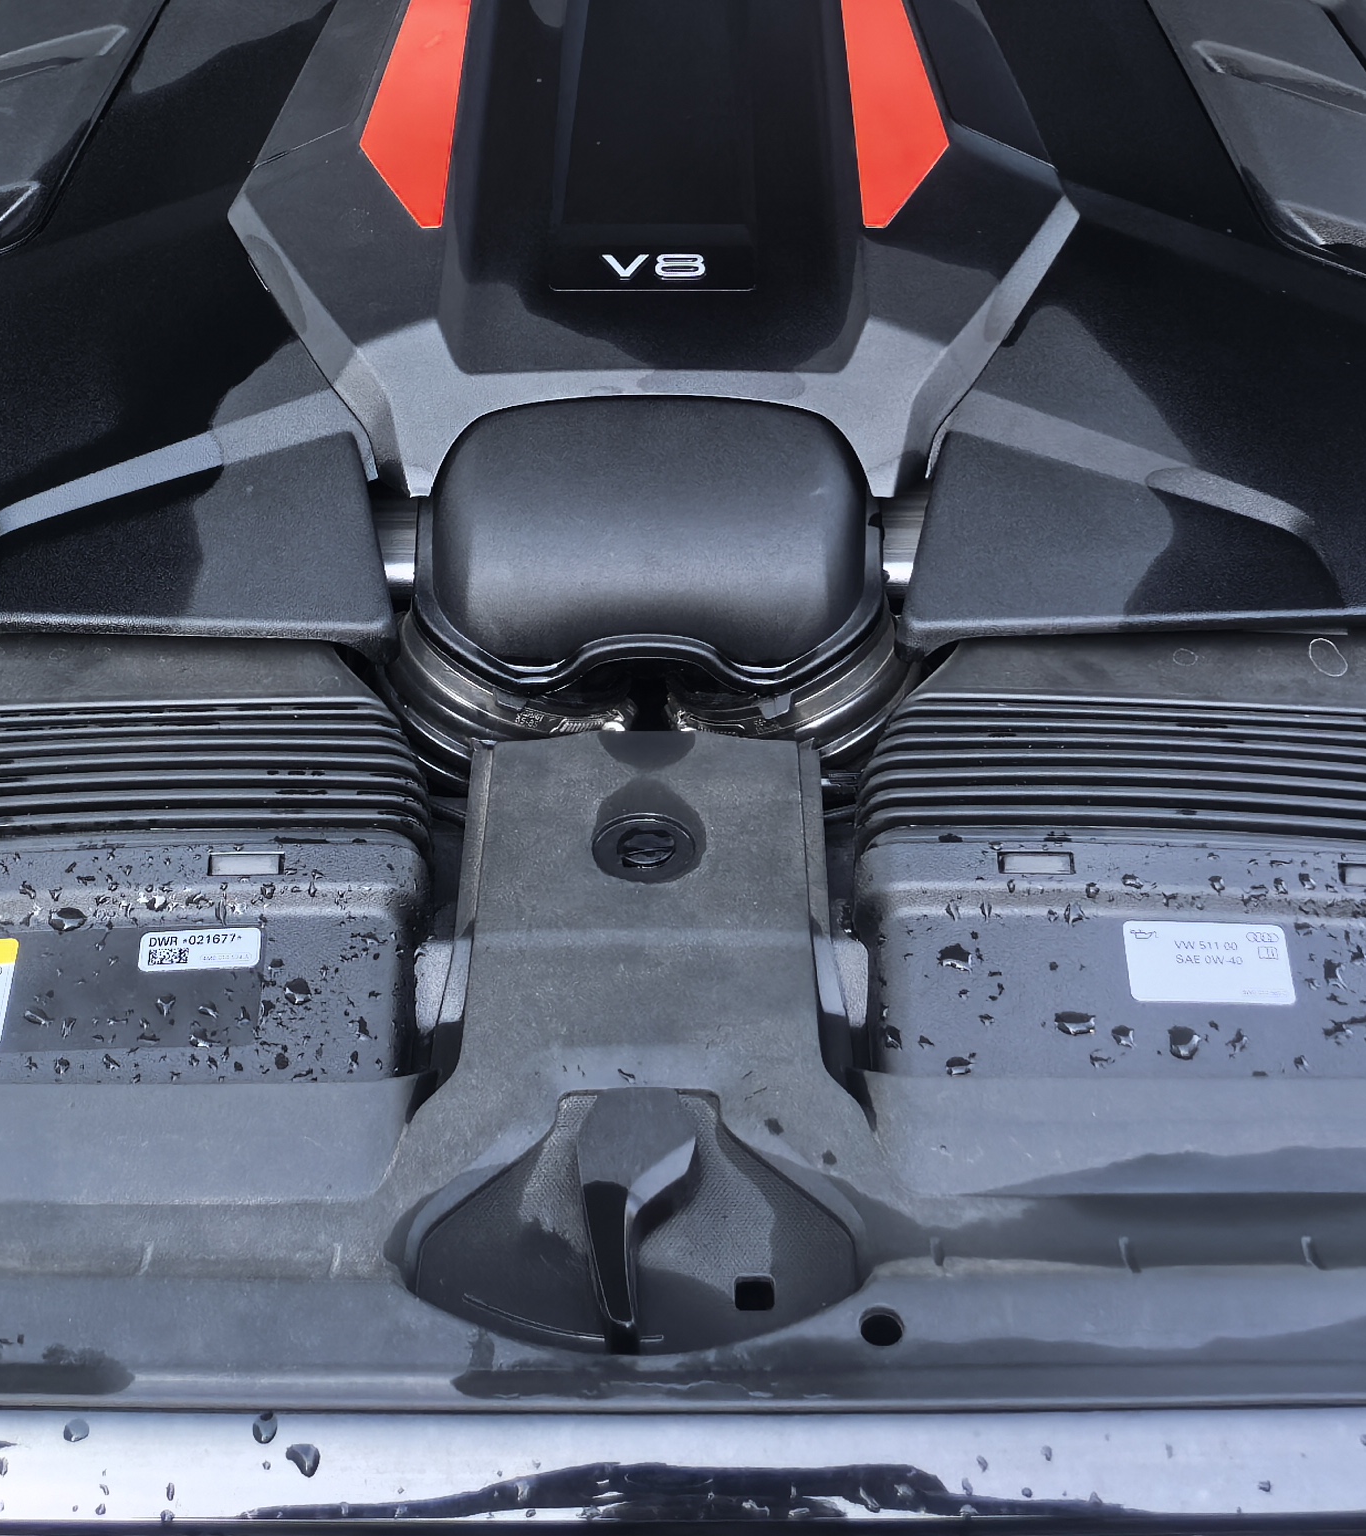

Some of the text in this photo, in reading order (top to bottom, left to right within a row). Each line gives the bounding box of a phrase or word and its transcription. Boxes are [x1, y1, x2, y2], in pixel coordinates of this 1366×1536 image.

[600, 253, 707, 281] V8
[148, 936, 179, 948] DWR
[1174, 940, 1239, 952] VW 511 00
[1175, 954, 1201, 965] SAE
